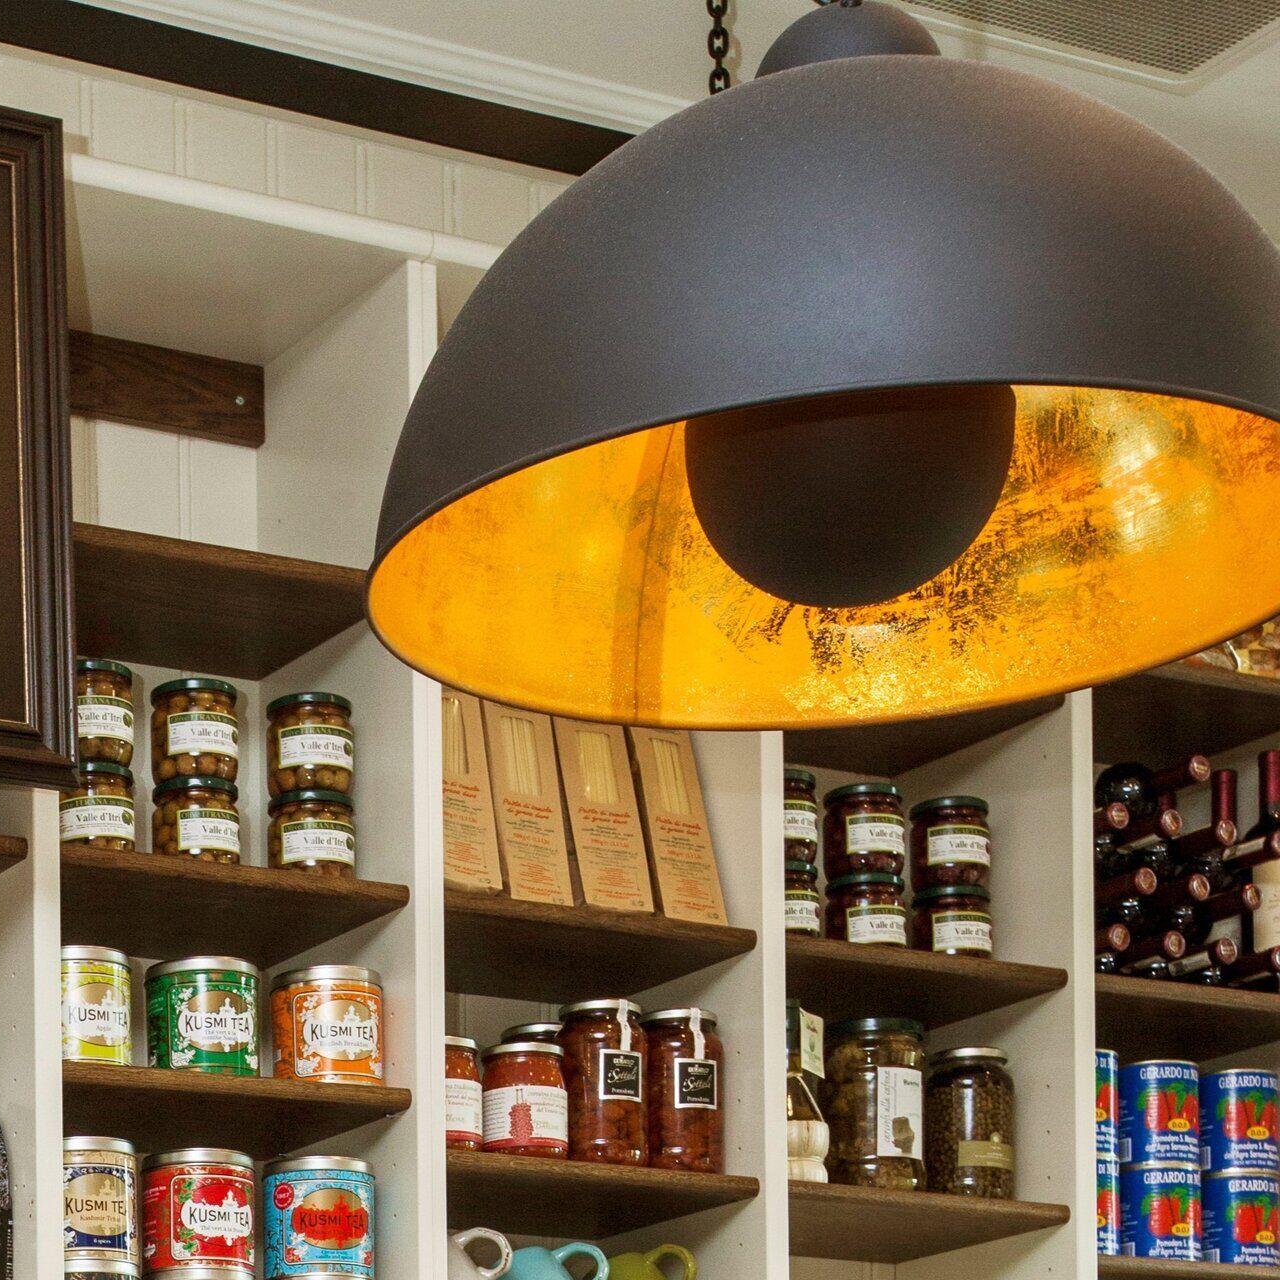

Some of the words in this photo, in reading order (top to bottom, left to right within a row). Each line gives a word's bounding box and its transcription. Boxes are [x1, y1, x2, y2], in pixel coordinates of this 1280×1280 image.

[191, 728, 211, 737] Valle
[301, 742, 321, 750] Valle
[76, 813, 98, 822] Valle
[202, 825, 221, 834] Valle
[304, 837, 324, 845] Valle
[68, 1006, 109, 1024] KUSMI
[113, 1010, 128, 1026] TEA
[185, 1015, 227, 1033] KUSMI
[232, 1019, 250, 1035] TEA
[311, 1023, 352, 1041] KUSMI
[356, 1026, 374, 1043] TEA
[1140, 1066, 1183, 1080] GERARDO
[1219, 1076, 1261, 1089] GERARDO
[1143, 1172, 1185, 1184] GERARDO
[1228, 1180, 1268, 1192] GERARDO
[65, 1197, 108, 1215] KUSMI
[189, 1207, 230, 1225] KUSMI
[234, 1211, 250, 1227] TEA
[299, 1212, 342, 1228] KUSMI
[346, 1214, 364, 1229] TEA
